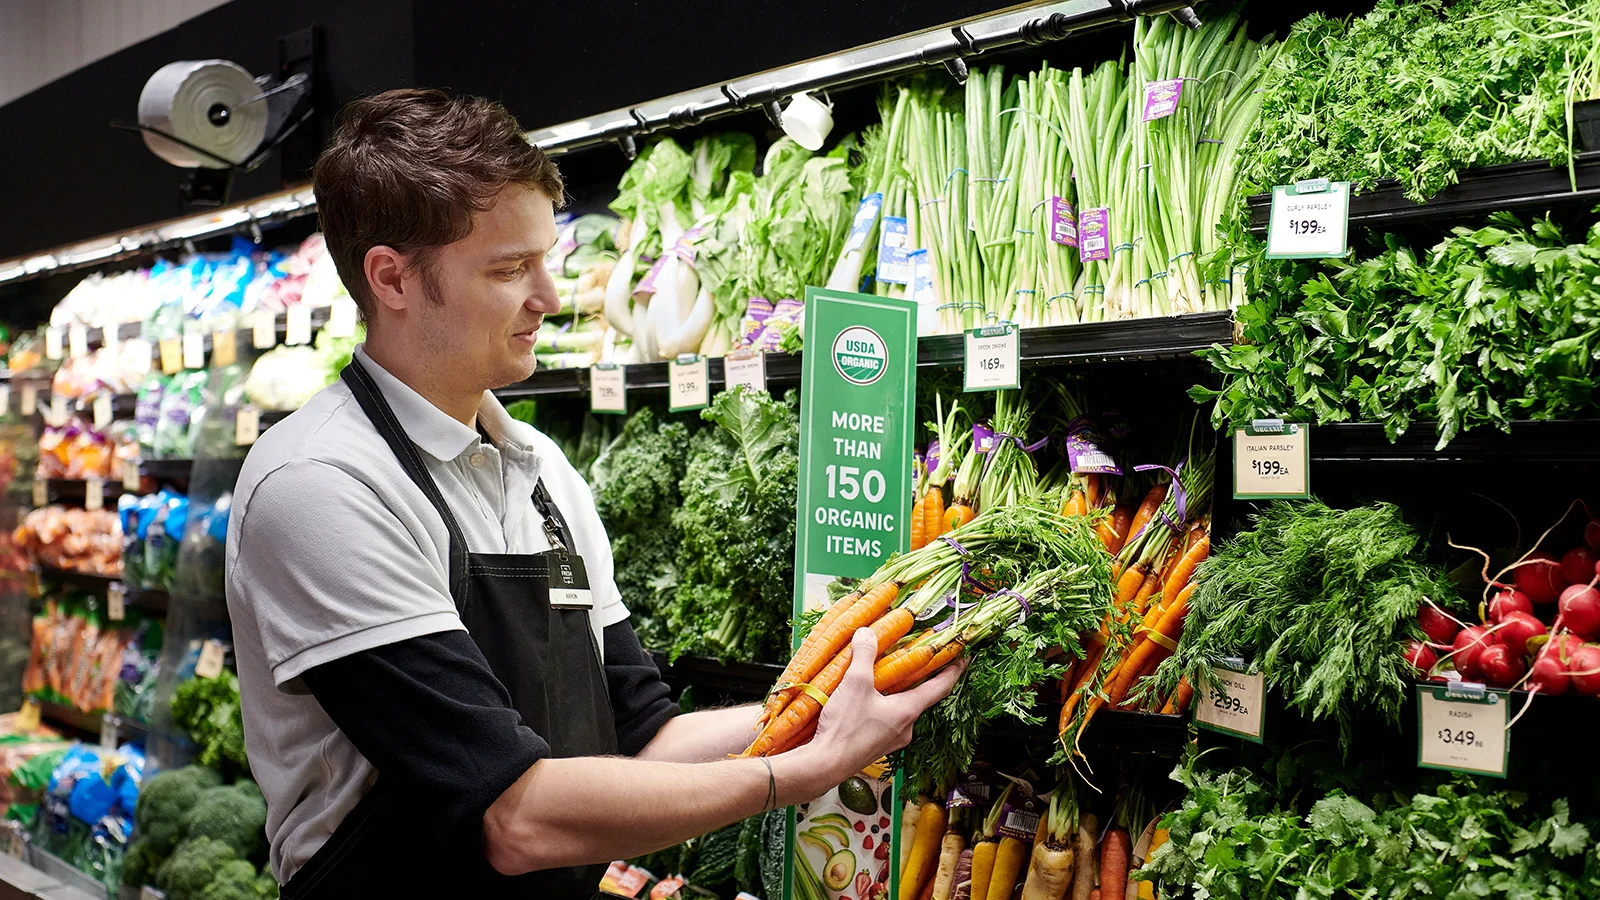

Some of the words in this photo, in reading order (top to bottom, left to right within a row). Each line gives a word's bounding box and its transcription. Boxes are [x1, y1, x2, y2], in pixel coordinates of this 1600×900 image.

[1306, 203, 1332, 211] PARSLEY
[846, 338, 876, 356] USDA
[840, 354, 880, 371] ORGANIC
[831, 410, 885, 435] MORE
[833, 436, 882, 461] THAN
[1269, 444, 1294, 452] PARSLEY
[825, 464, 887, 504] 150
[814, 506, 895, 533] ORGANIC
[825, 534, 882, 558] ITEMS
[1234, 681, 1246, 690] DILL
[1448, 710, 1473, 719] RADISH
